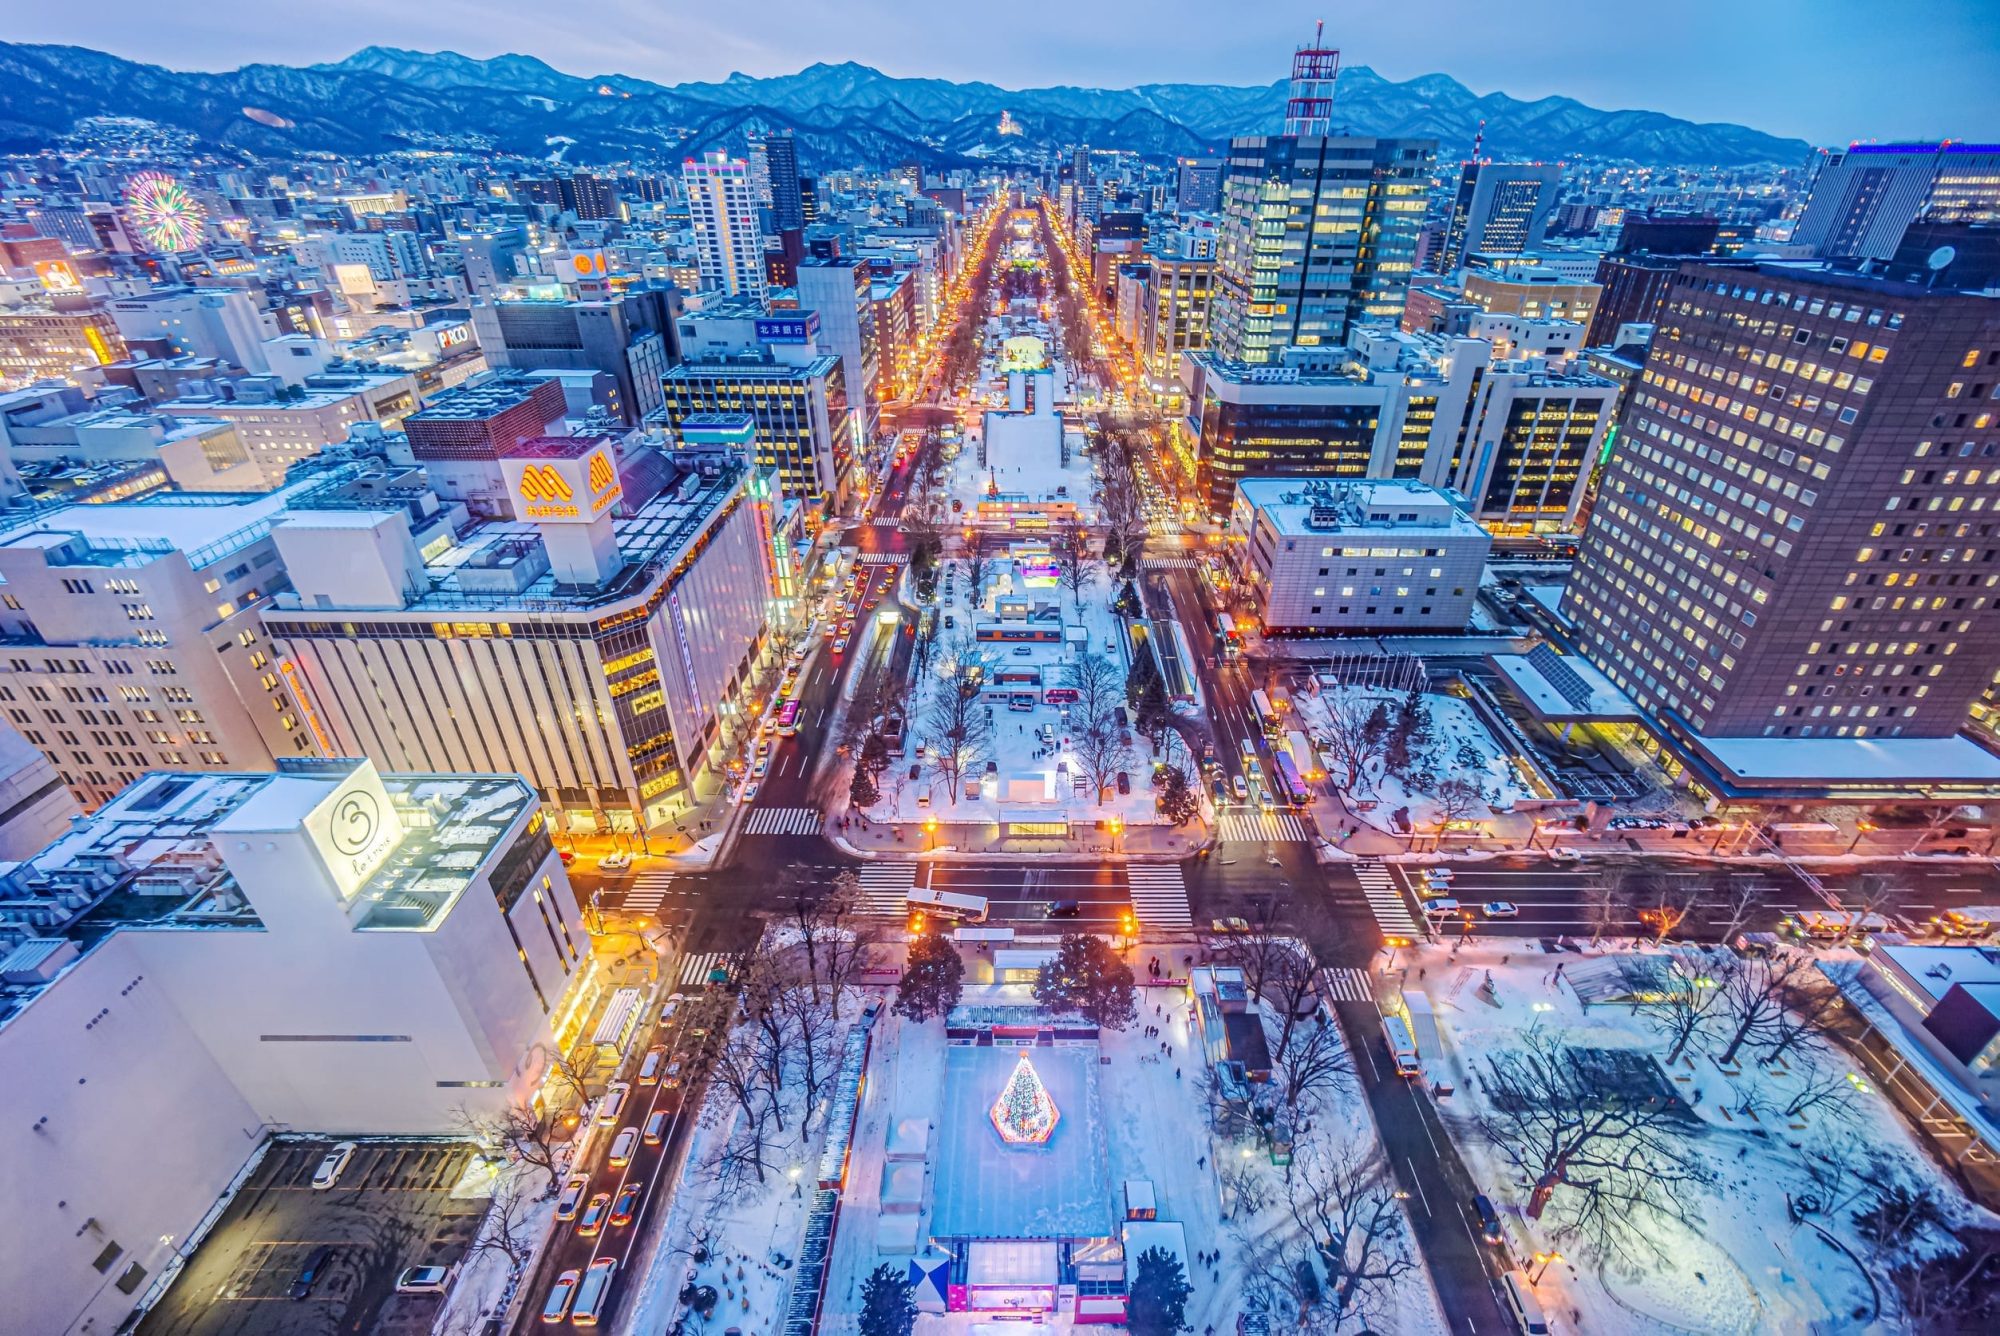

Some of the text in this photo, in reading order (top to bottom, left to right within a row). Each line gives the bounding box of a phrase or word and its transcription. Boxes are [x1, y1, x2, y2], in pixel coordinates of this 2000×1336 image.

[437, 326, 468, 349] PARCO
[760, 325, 804, 335] 北洋銀行
